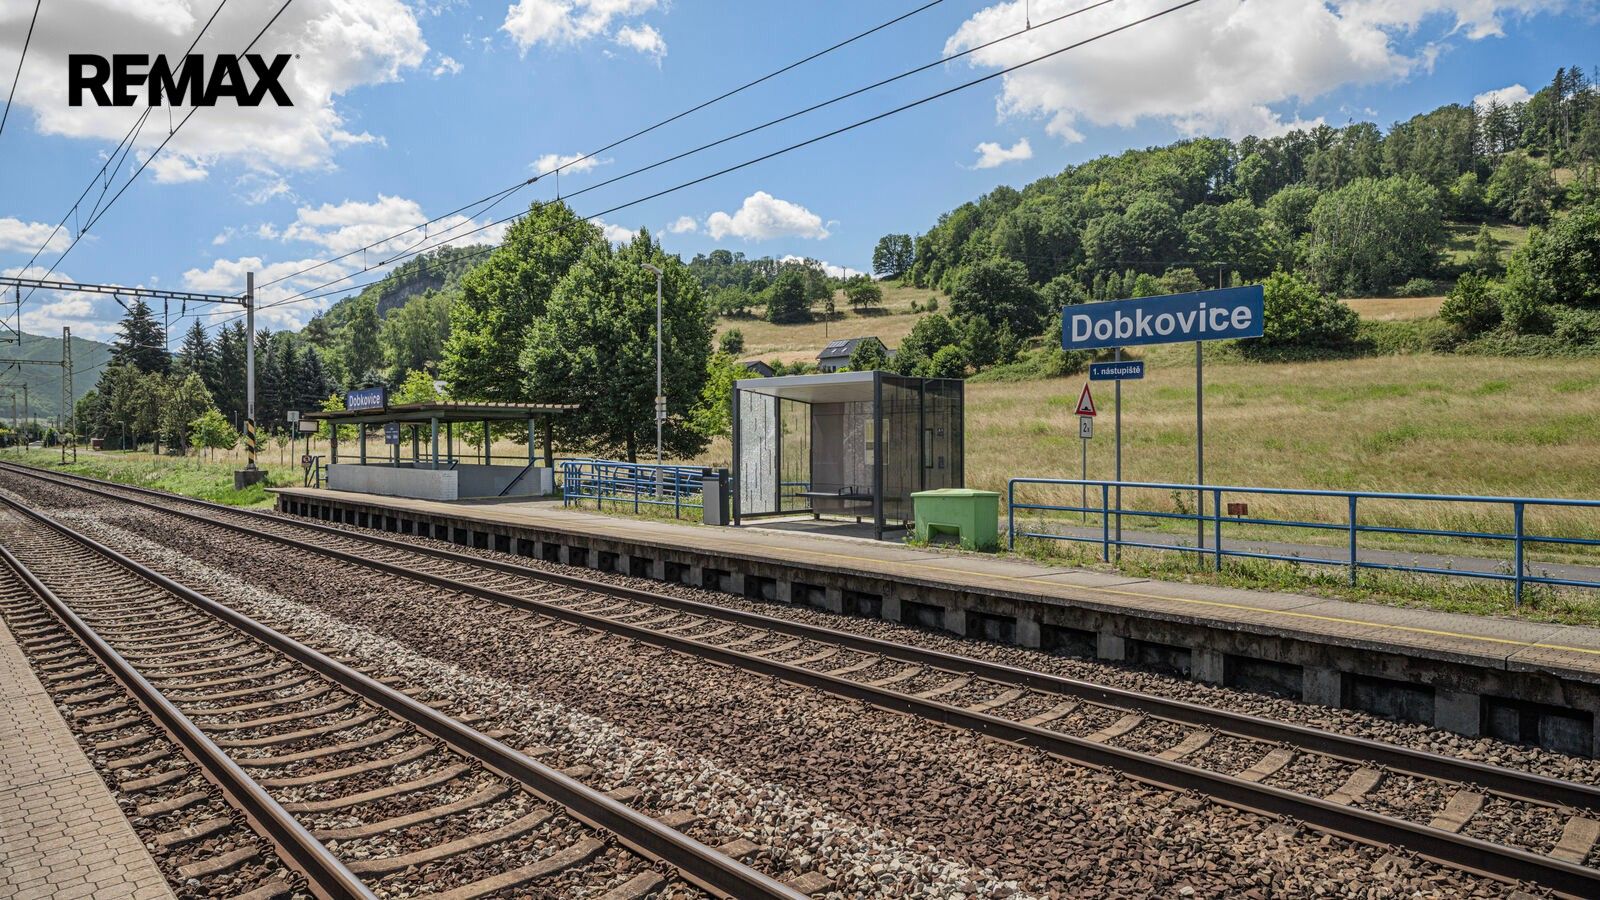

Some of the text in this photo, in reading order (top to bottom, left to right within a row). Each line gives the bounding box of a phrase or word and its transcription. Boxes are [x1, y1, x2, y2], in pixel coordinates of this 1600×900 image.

[1071, 302, 1252, 342] Dobkovice
[1092, 366, 1141, 376] 1. nástupiště
[350, 393, 380, 407] Dobkovice
